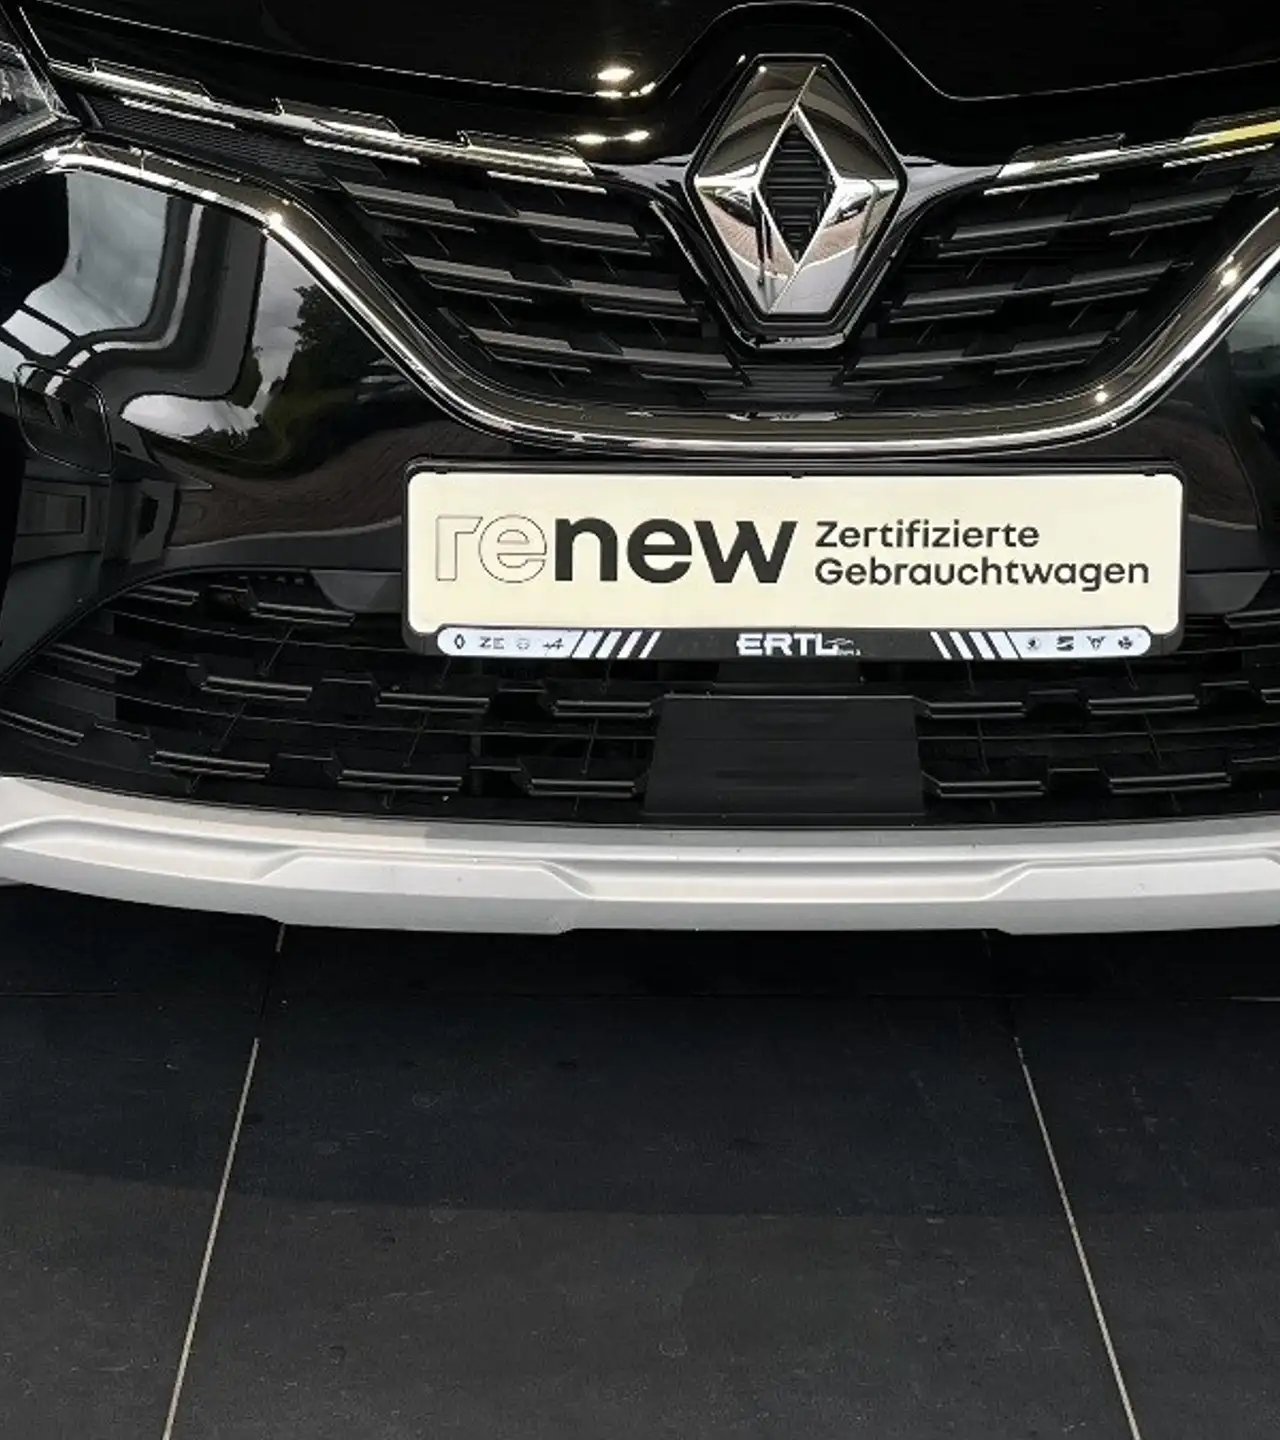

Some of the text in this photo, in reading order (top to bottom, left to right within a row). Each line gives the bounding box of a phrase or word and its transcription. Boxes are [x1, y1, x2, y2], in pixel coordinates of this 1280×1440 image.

[435, 514, 1040, 584] renew Zertifizierte
[814, 556, 1150, 592] Gebrauchtwagen
[735, 632, 839, 657] ERTL
